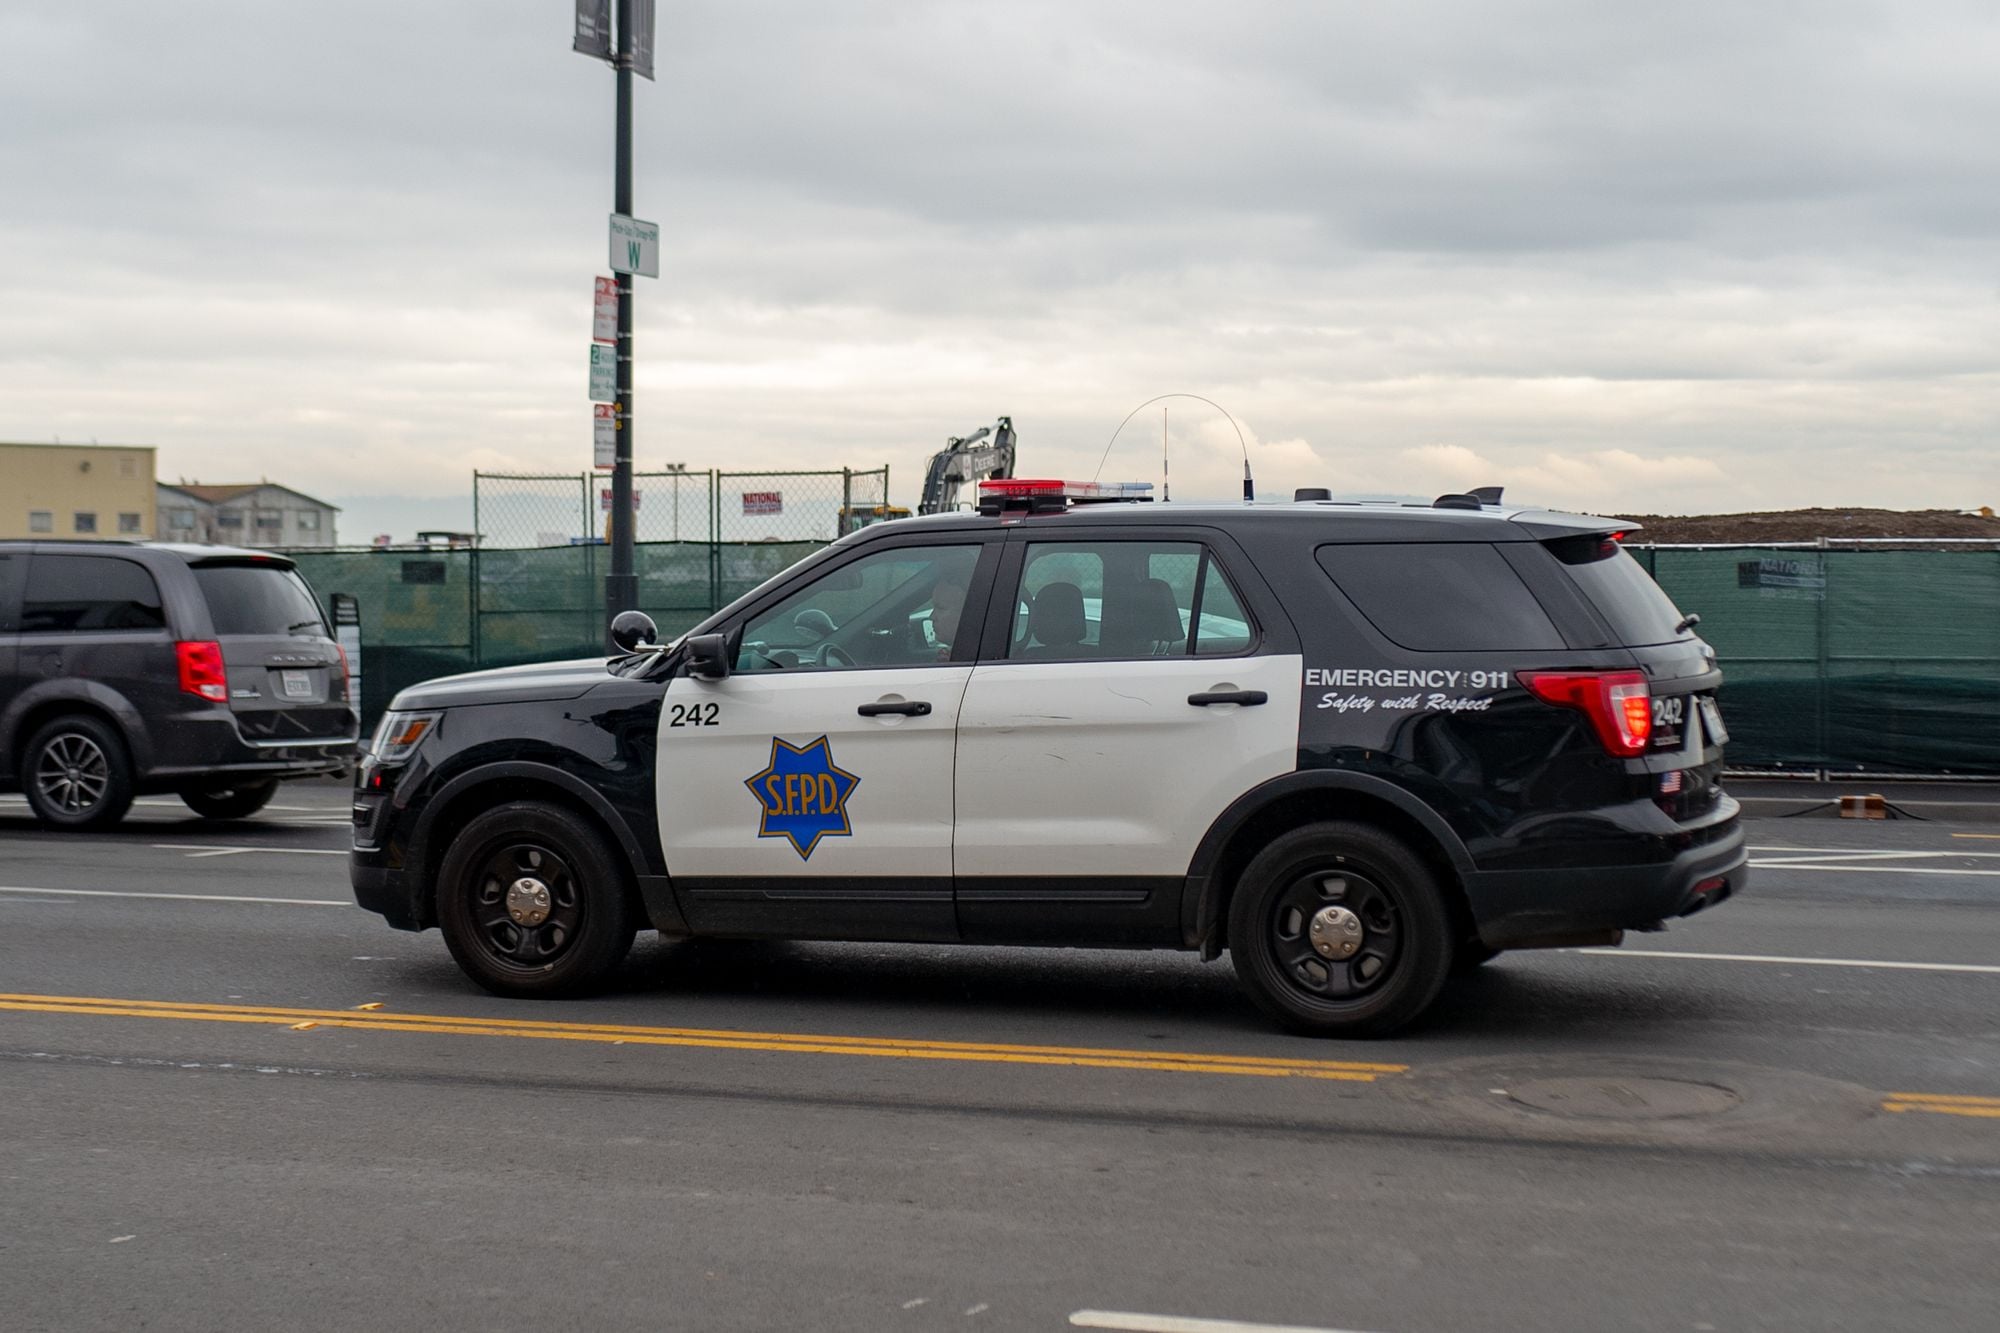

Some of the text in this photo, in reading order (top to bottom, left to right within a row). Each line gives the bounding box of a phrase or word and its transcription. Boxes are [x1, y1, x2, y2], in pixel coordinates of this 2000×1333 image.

[628, 240, 640, 269] W
[592, 346, 600, 363] 2
[743, 492, 782, 504] NATIONAL
[1305, 668, 1462, 688] EMERGENCY
[1470, 670, 1509, 689] 911
[1317, 692, 1493, 714] Safety with Respect
[1653, 698, 1683, 726] 242
[670, 703, 720, 727] 242
